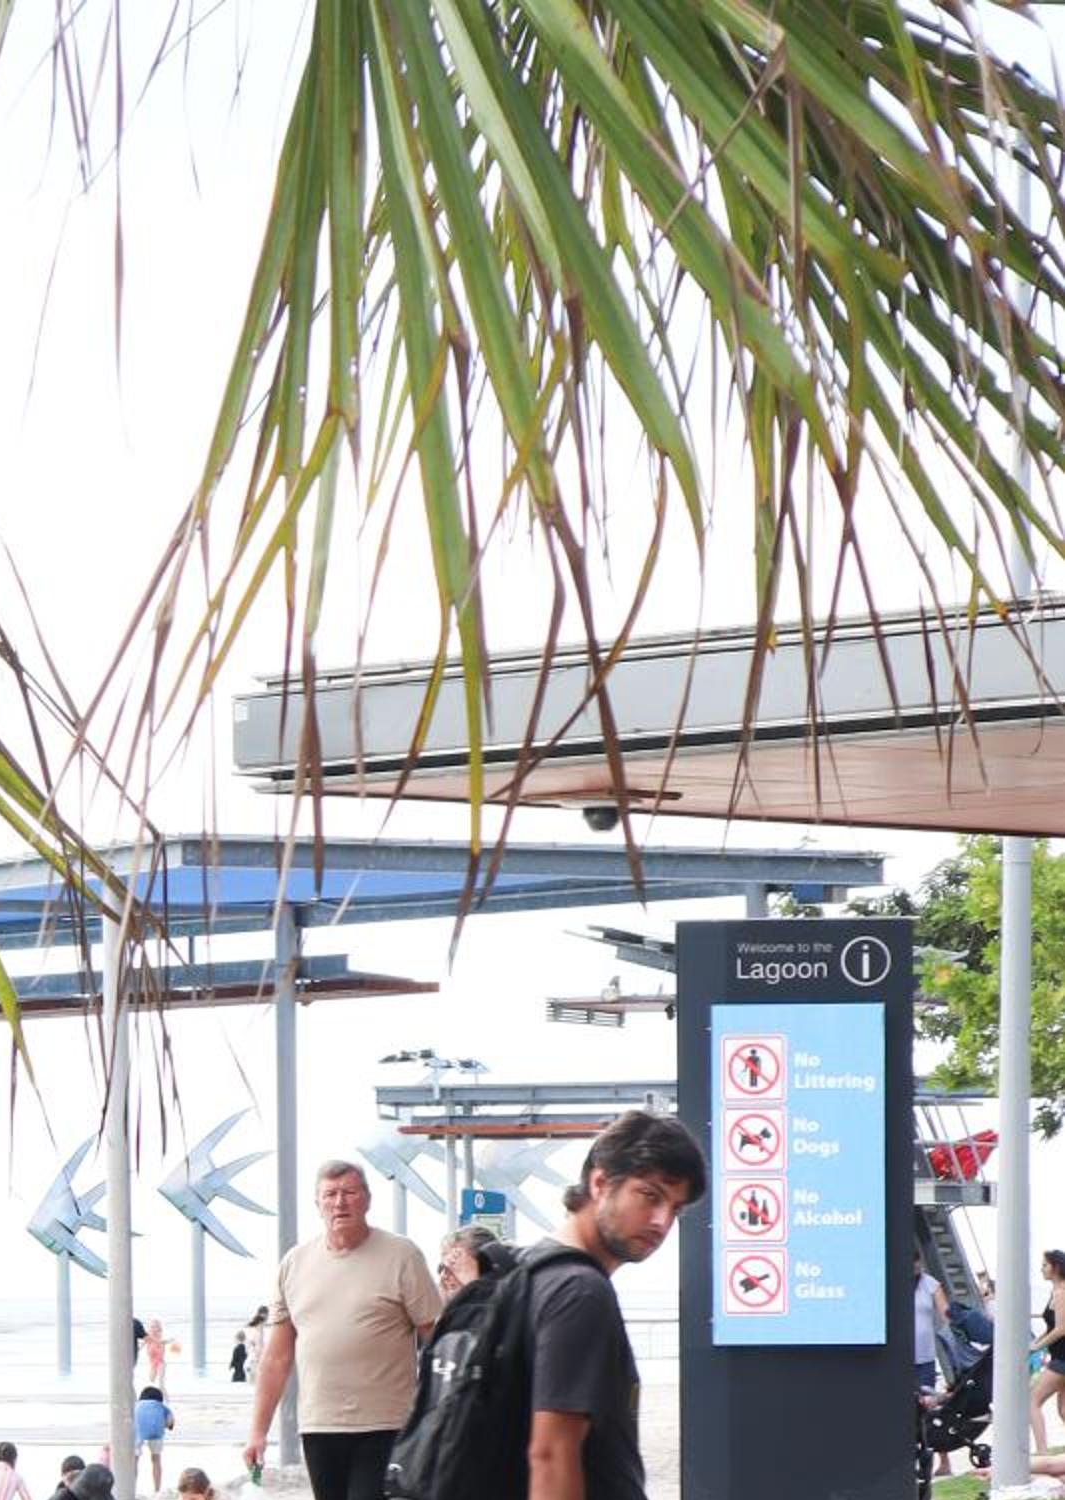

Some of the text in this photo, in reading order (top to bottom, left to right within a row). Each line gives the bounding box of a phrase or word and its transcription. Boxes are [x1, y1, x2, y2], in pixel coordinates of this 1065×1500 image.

[737, 942, 833, 953] Welcome to the
[736, 957, 828, 985] Lagoon
[793, 1053, 821, 1068] No
[794, 1072, 876, 1092] Littering
[793, 1117, 820, 1133] No
[793, 1138, 840, 1157] Dogs
[793, 1189, 820, 1204] No
[793, 1208, 863, 1226] Alcohol
[795, 1262, 822, 1277] No
[795, 1282, 846, 1299] Glass
